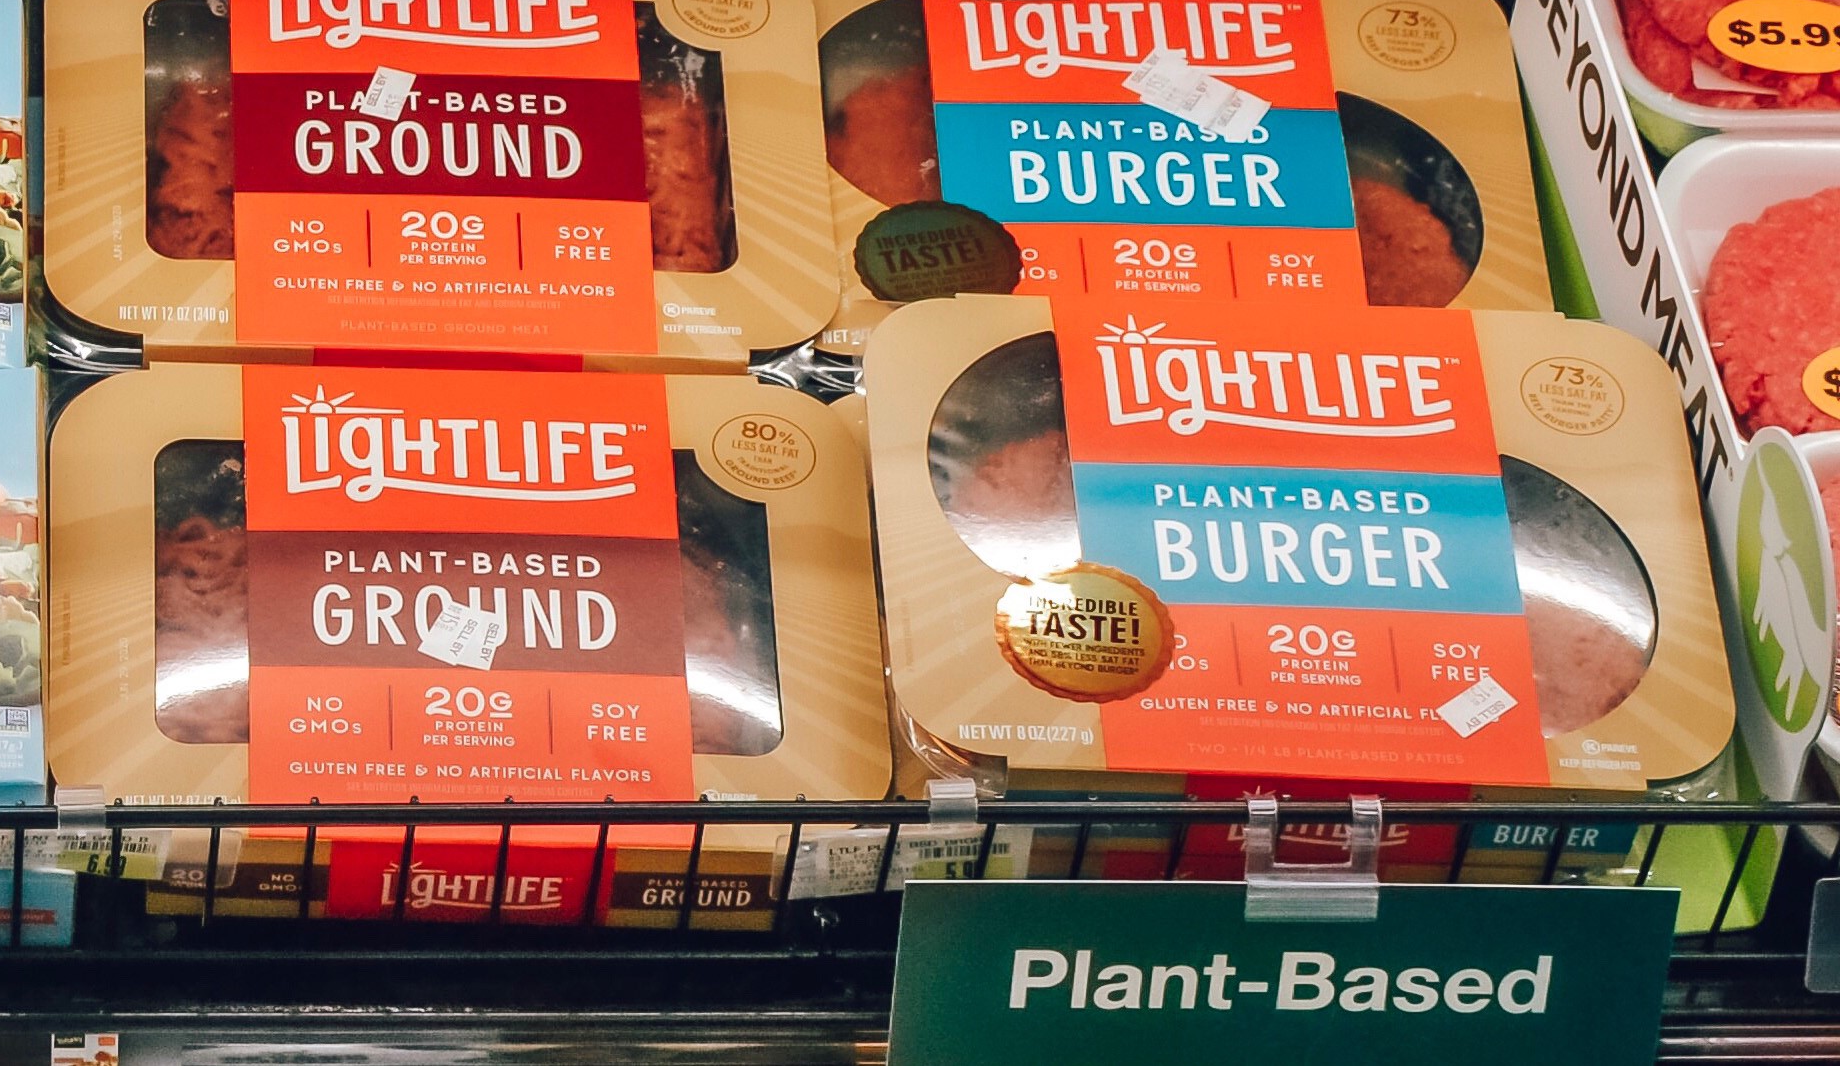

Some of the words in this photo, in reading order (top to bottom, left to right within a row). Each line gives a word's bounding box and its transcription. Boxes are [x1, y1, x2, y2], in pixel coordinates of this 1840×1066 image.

[1385, 8, 1437, 28] 73%
[305, 88, 568, 115] PLAT-BASED
[295, 119, 583, 180] GROUND
[1008, 150, 1287, 209] BURGER
[290, 220, 325, 234] NO
[400, 210, 485, 240] 20G
[558, 226, 605, 240] SOY
[400, 253, 426, 264] PER
[429, 254, 487, 266] SERVING
[410, 241, 476, 253] PROTEIN
[555, 244, 611, 261] FREE
[1113, 240, 1199, 269] 20G
[273, 277, 339, 291] GLUTEN
[345, 278, 384, 291] FREE
[412, 282, 437, 293] NO
[443, 283, 532, 296] ARTIFICIAL
[539, 284, 616, 298] FLAVORS
[1549, 363, 1604, 389] 73%
[732, 440, 756, 451] LESS
[742, 421, 795, 446] 80%
[1154, 484, 1432, 514] PLANT-BASED
[324, 550, 602, 578] PLANT-BASED
[1153, 519, 1449, 590] BURGER
[1026, 611, 1140, 645] TASTE!
[1267, 624, 1357, 657] 20G
[1281, 658, 1350, 672] PROTEIN
[1270, 672, 1299, 685] PER
[1302, 673, 1362, 687] SERVING
[424, 686, 513, 719] 20G
[1009, 949, 1555, 1016] Plant-Based
